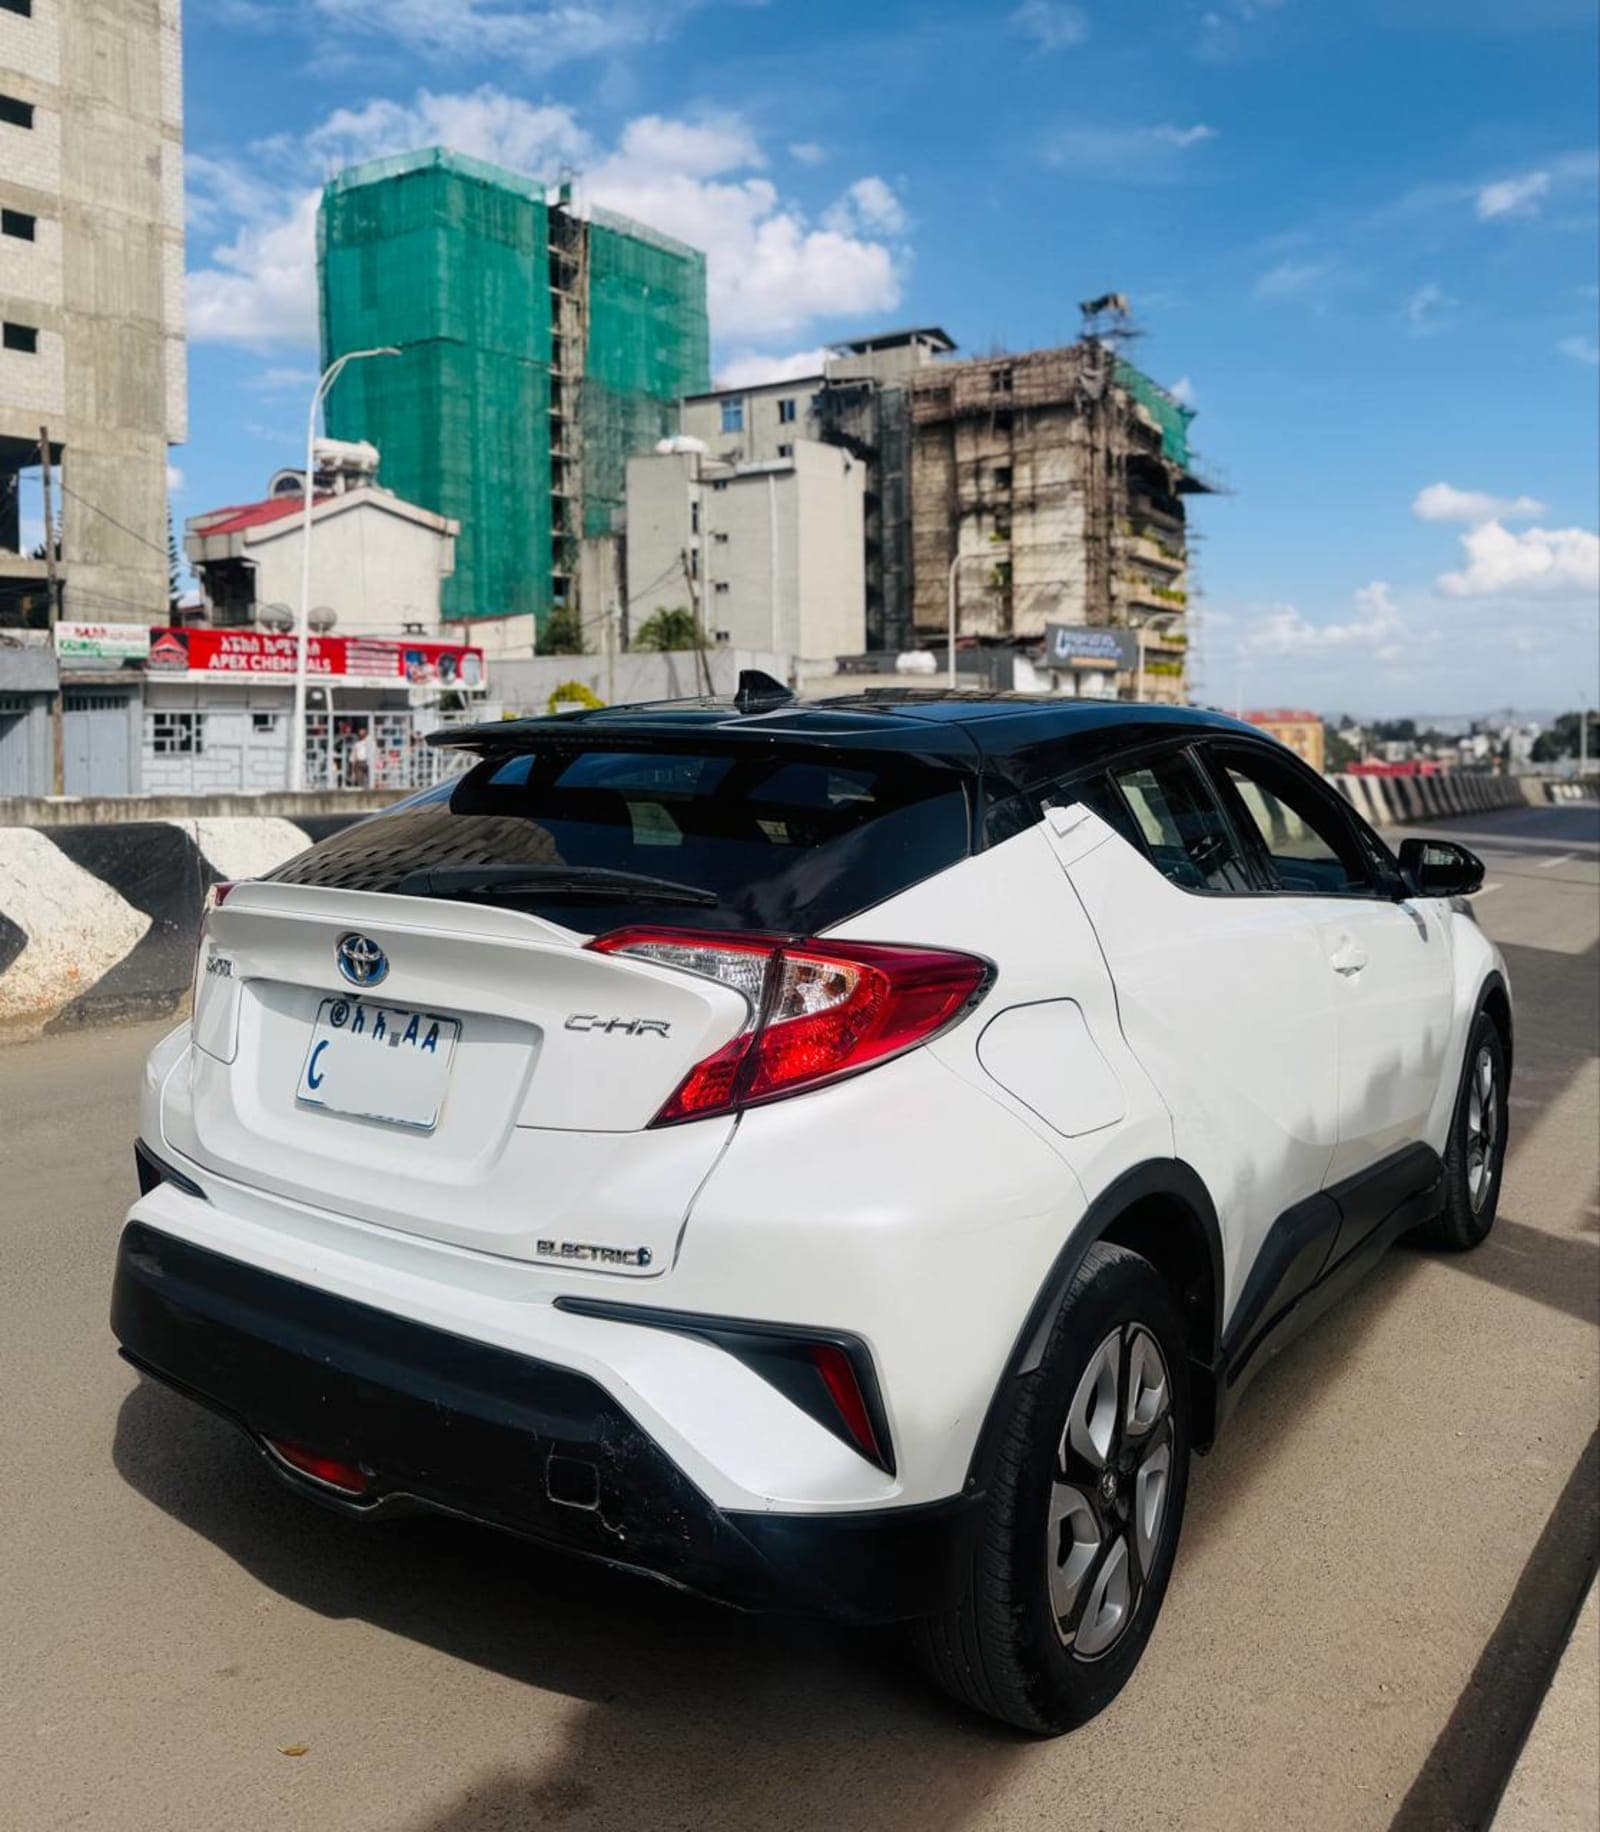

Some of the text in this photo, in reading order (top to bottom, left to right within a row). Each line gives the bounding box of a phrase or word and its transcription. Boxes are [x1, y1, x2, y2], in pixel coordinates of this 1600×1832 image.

[209, 653, 248, 670] APEX
[402, 1014, 439, 1053] AA
[564, 1014, 671, 1039] C-HR
[537, 1240, 638, 1265] ELECTRIC
